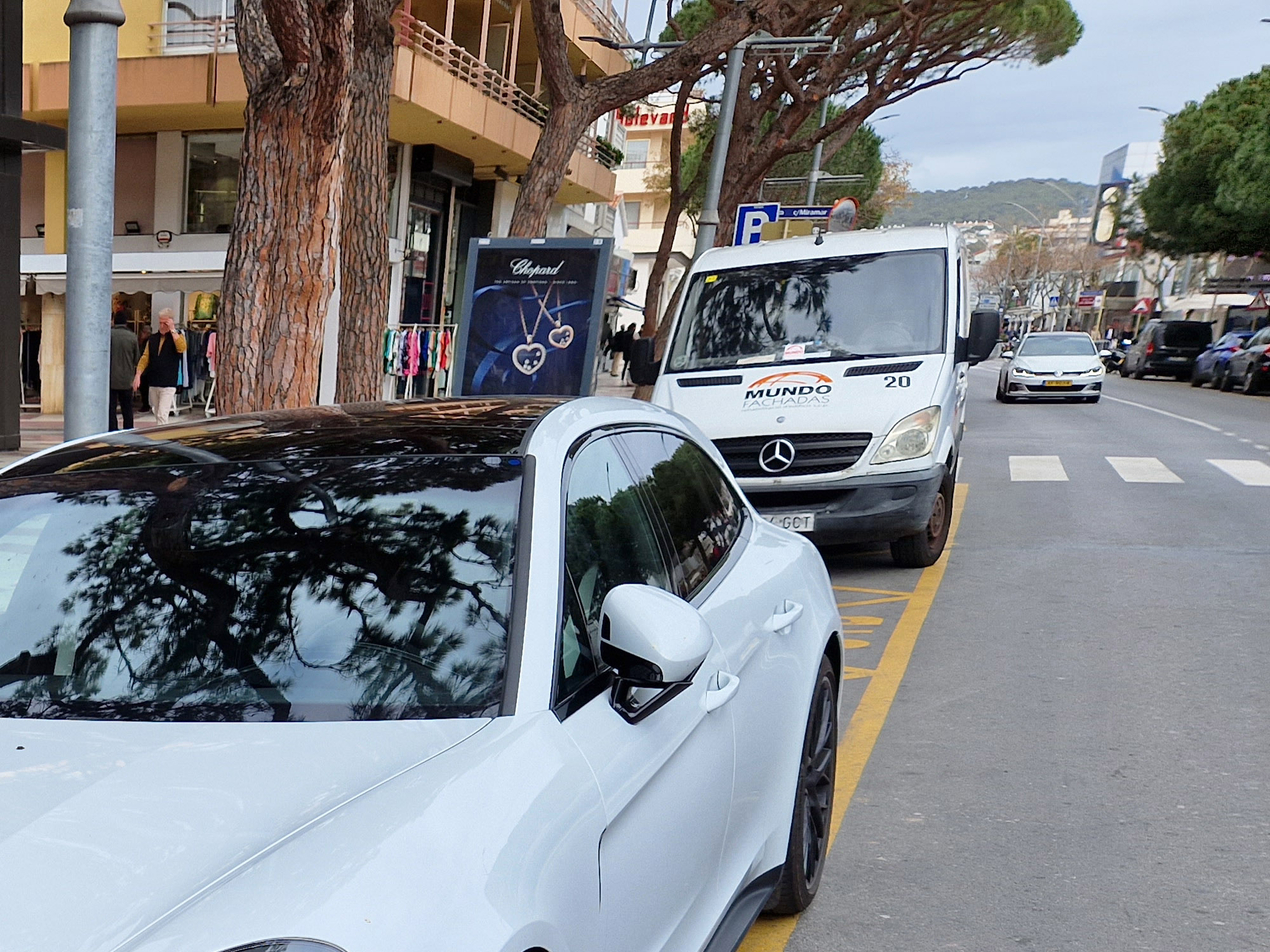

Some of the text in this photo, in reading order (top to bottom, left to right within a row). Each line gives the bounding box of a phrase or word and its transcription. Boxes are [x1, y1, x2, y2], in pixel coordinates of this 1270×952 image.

[510, 258, 565, 278] Chopard
[884, 375, 911, 388] 20
[744, 384, 832, 400] MUNDO
[742, 395, 831, 409] FACHADAS
